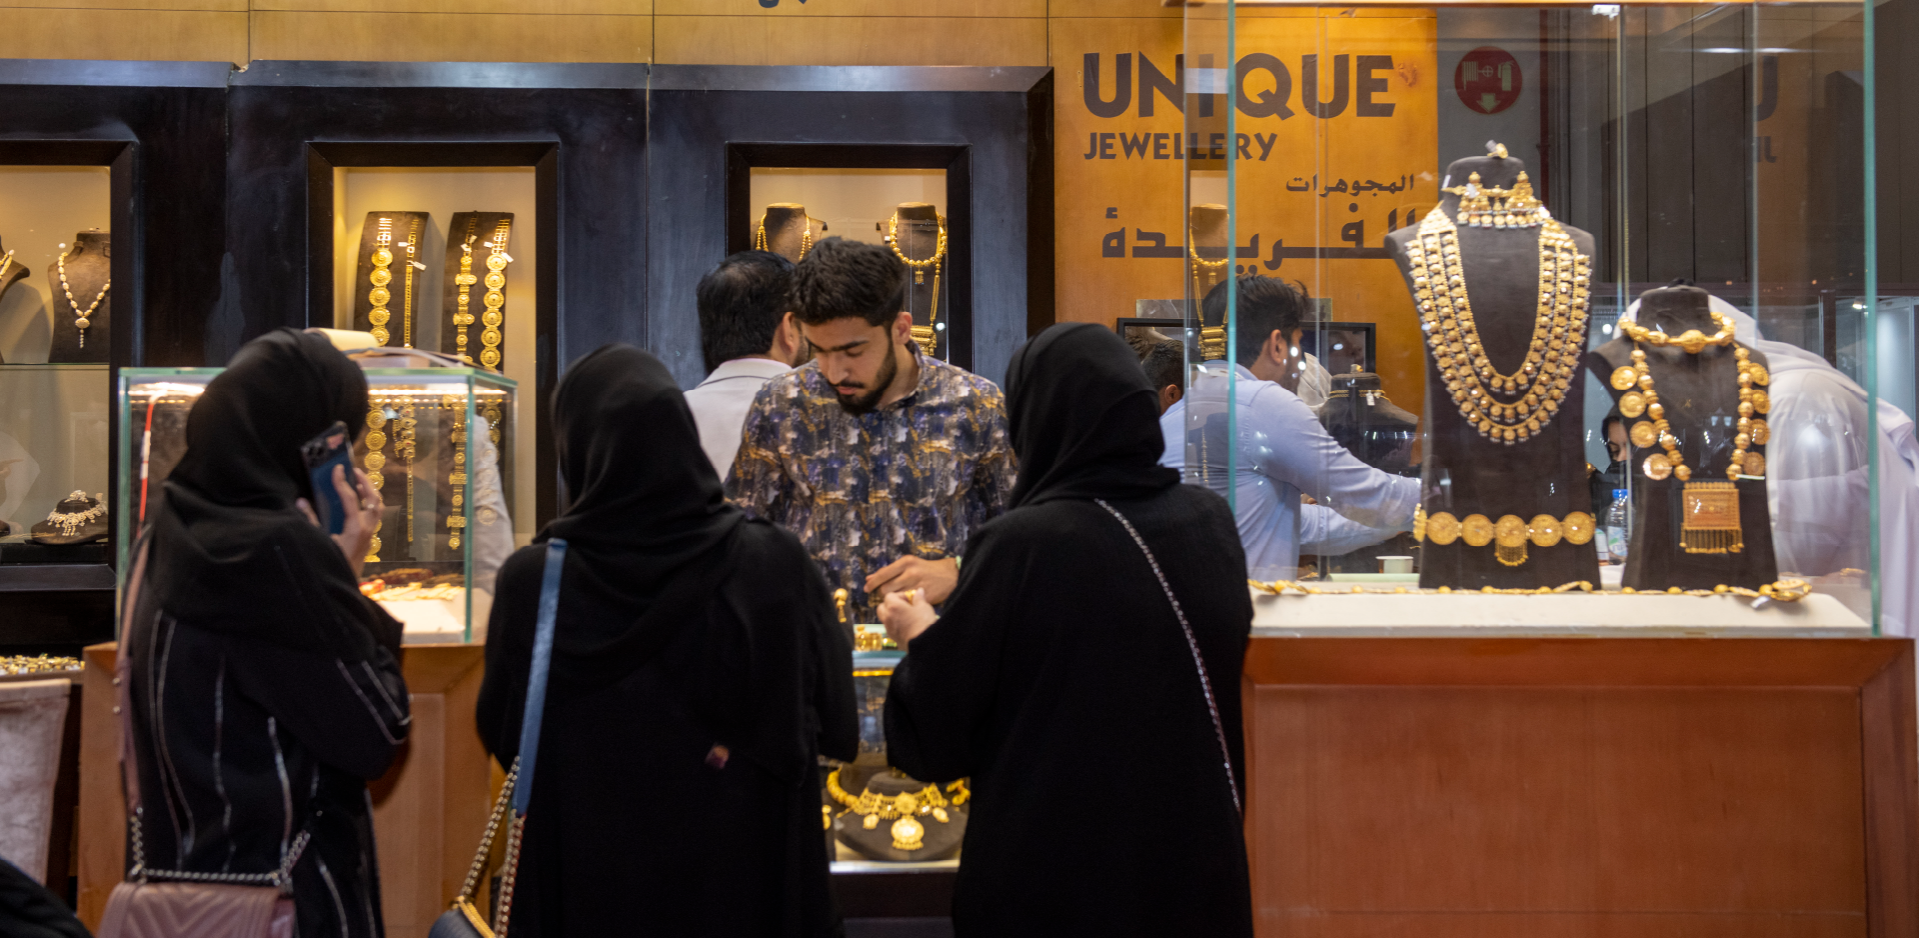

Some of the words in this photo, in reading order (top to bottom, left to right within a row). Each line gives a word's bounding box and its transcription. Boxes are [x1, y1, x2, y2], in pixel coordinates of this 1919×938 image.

[1083, 50, 1397, 121] UNIQUE
[1083, 131, 1278, 162] JEWELLERY
[1286, 173, 1414, 198] المجوهرات
